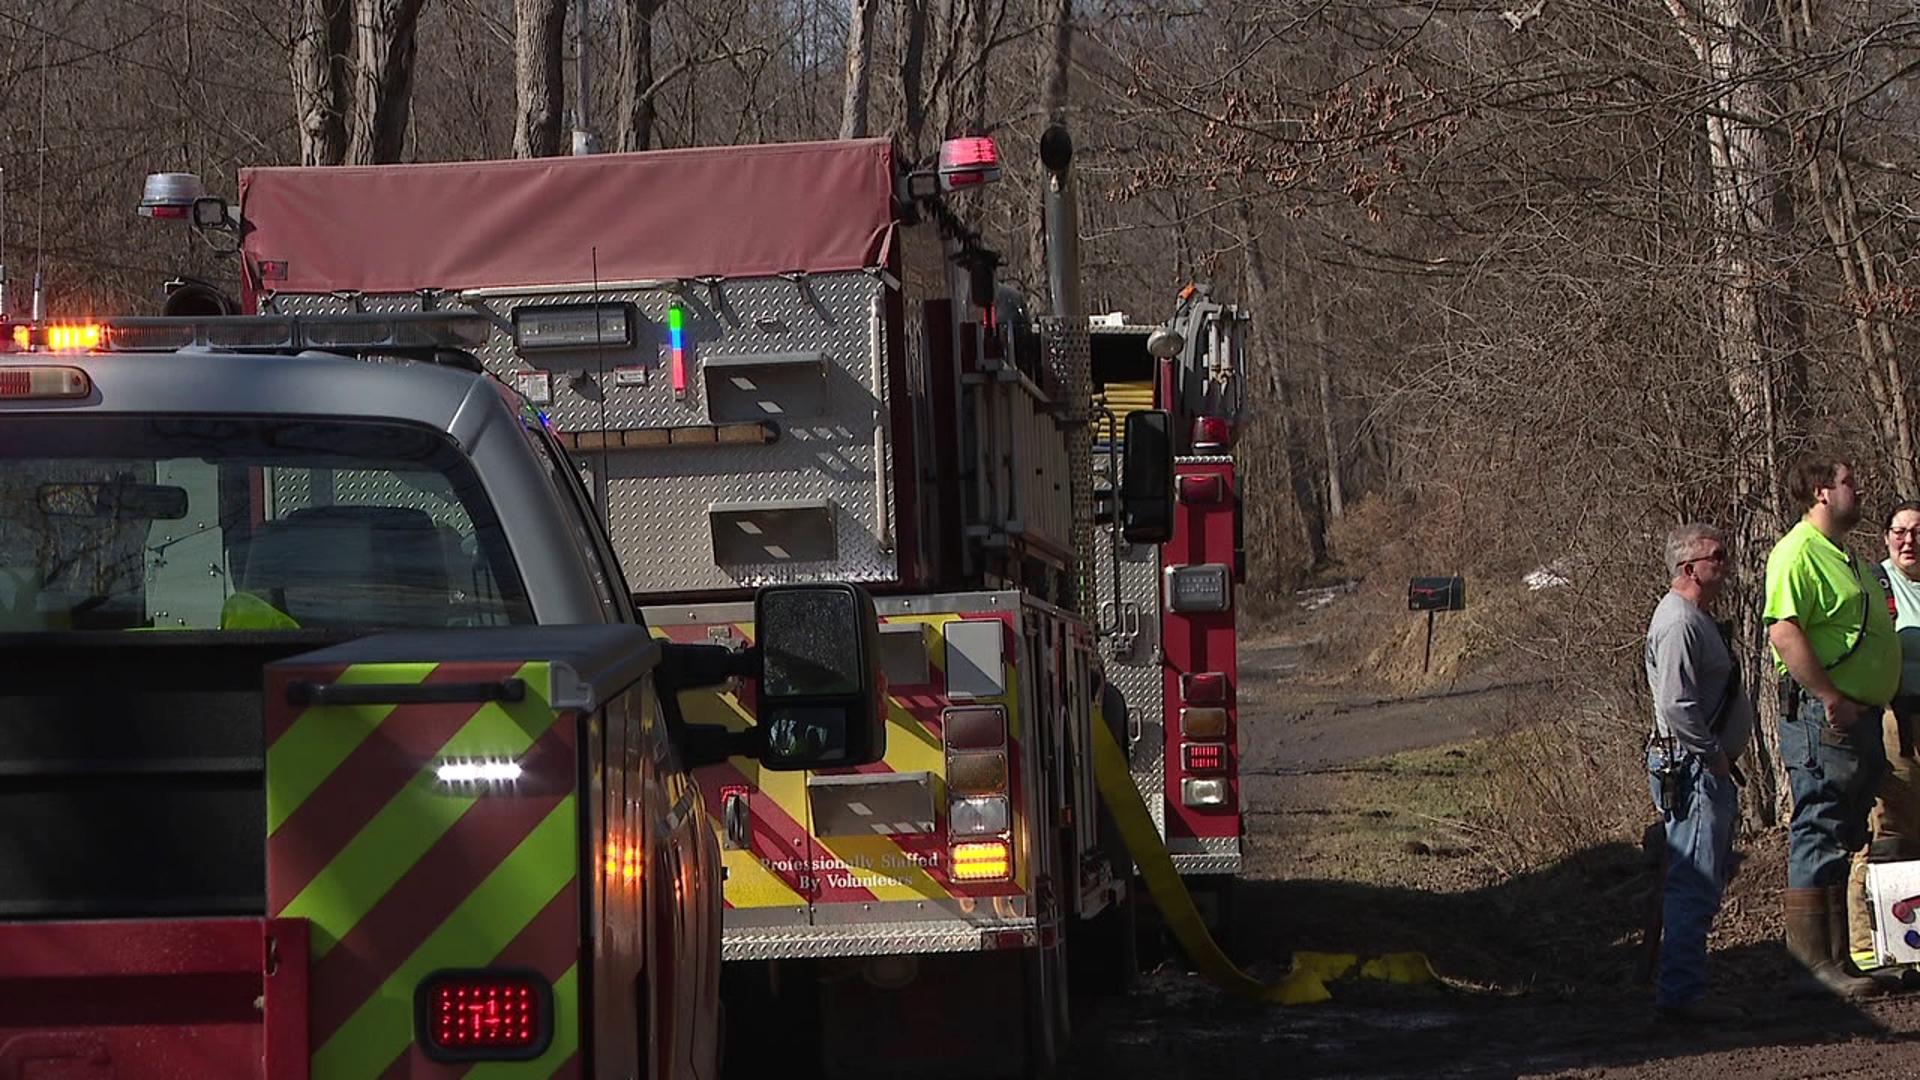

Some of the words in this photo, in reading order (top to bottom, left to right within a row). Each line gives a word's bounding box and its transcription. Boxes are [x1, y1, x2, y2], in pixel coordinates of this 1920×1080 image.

[760, 853, 874, 872] Professionally
[881, 851, 939, 869] Staffed
[799, 875, 822, 893] By
[826, 873, 913, 889] Volunteers
